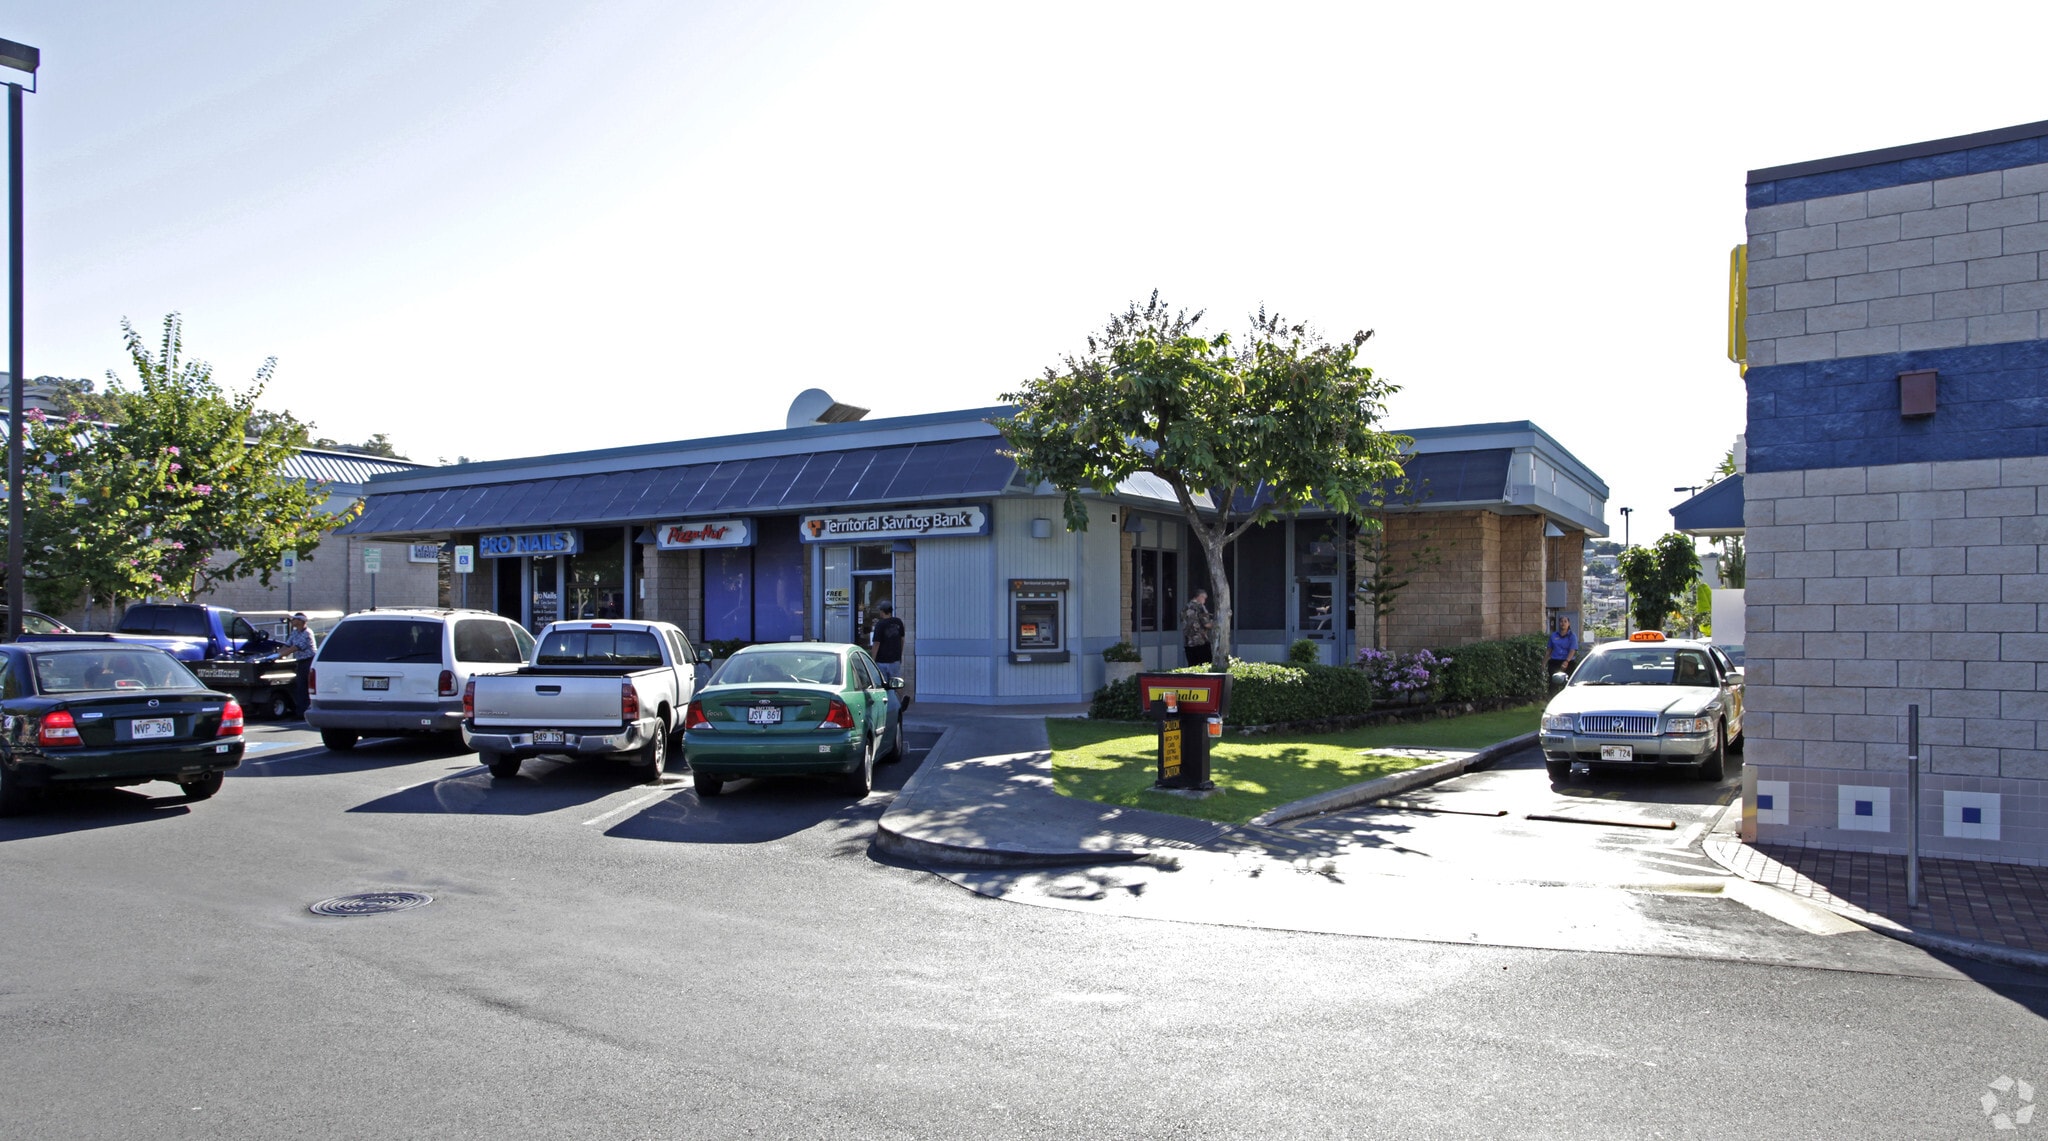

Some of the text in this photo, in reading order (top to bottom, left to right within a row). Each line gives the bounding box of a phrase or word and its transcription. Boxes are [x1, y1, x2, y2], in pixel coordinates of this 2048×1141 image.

[825, 512, 966, 532] Territorial Savings Bank
[667, 524, 726, 544] Pizza Hut
[480, 533, 565, 554] PRO NAILS
[750, 710, 780, 720] JSV 867
[134, 722, 173, 734] NVP 360
[533, 732, 548, 742] 349
[1602, 749, 1631, 758] PNR 724
